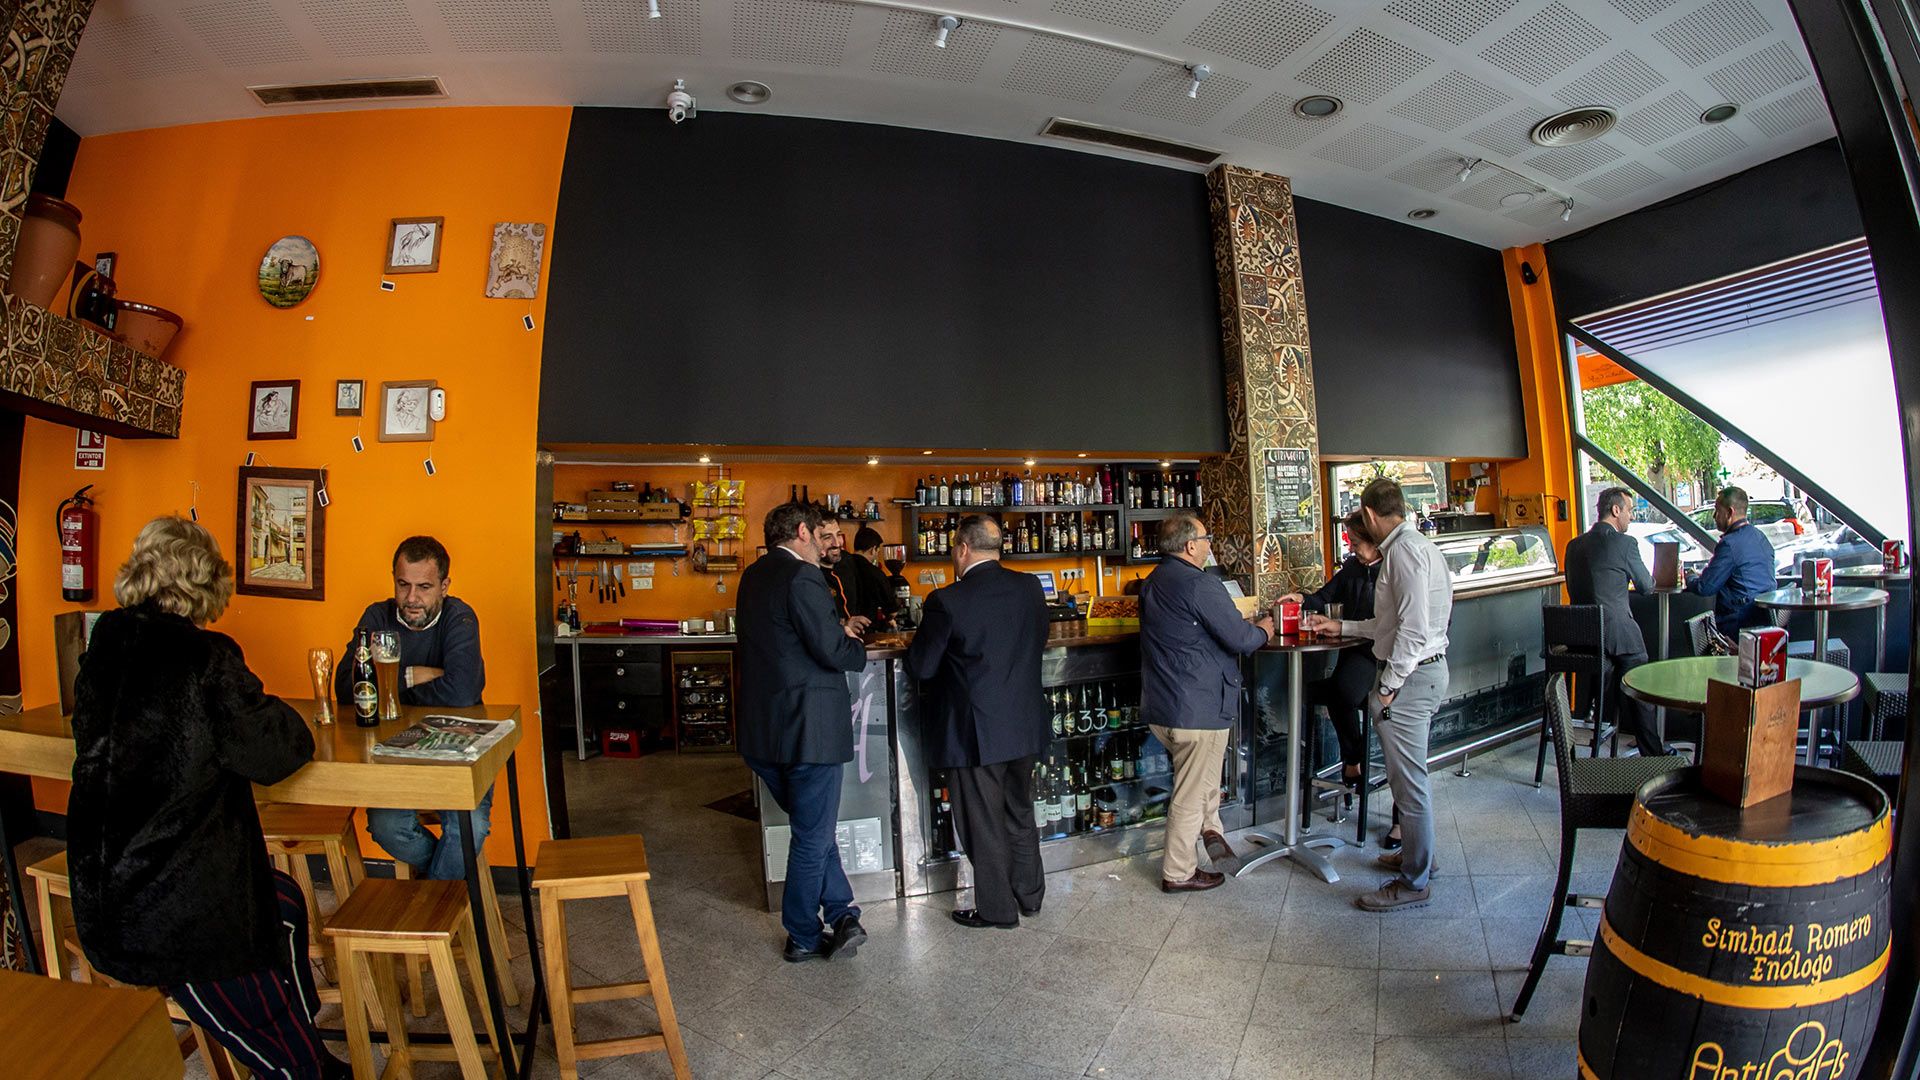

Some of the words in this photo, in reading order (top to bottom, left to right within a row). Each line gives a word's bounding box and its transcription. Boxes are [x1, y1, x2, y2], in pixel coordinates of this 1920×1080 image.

[1702, 917, 1795, 955] Simbad
[1806, 913, 1872, 954] Romero
[1750, 950, 1833, 985] Enólogo
